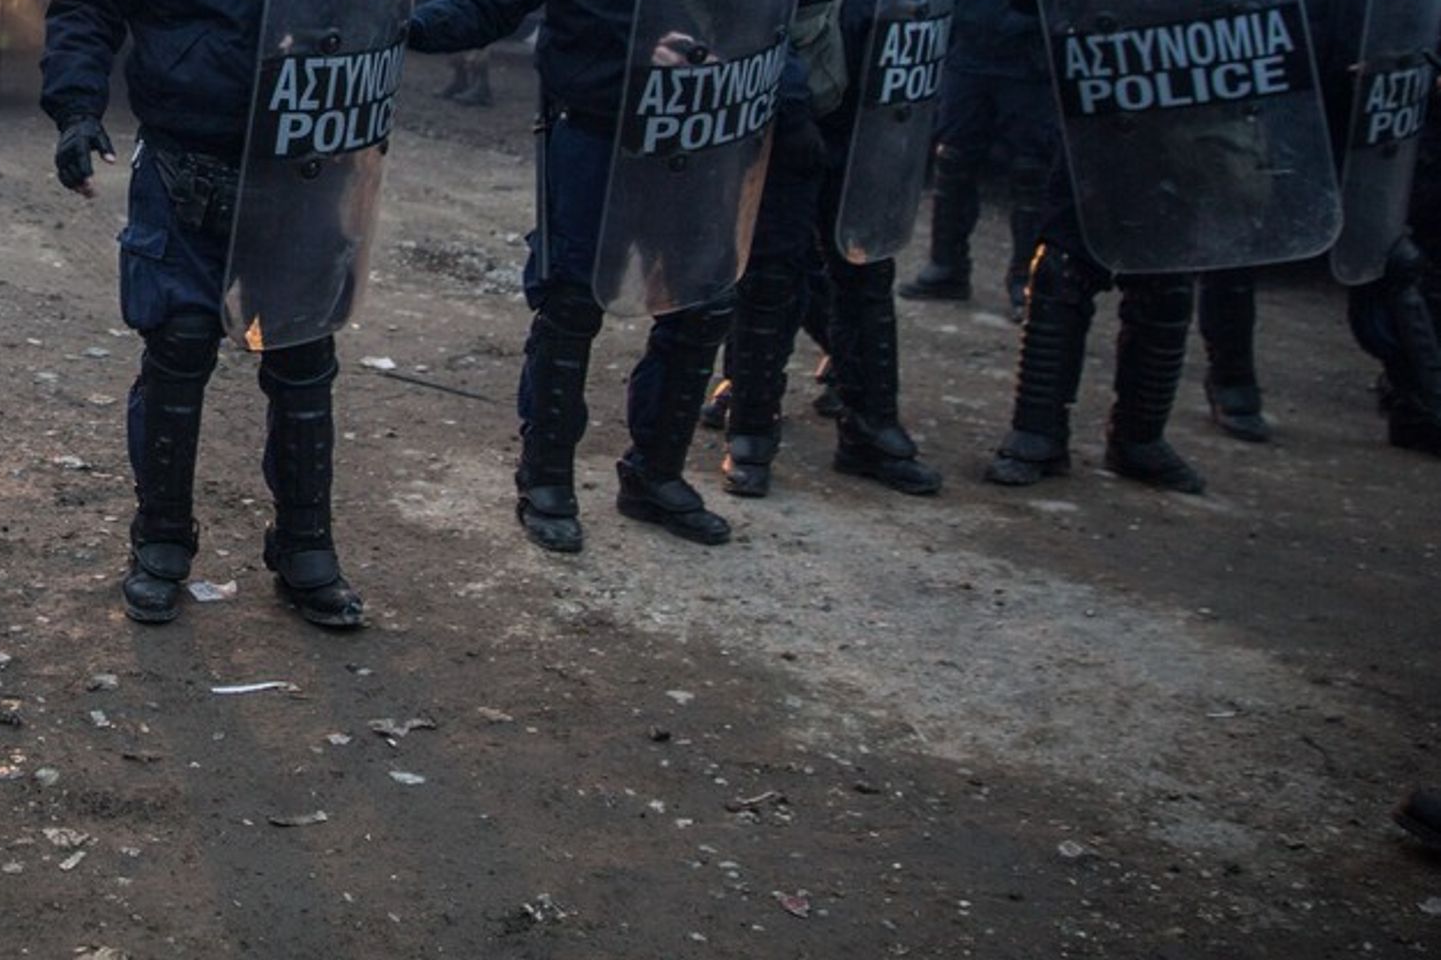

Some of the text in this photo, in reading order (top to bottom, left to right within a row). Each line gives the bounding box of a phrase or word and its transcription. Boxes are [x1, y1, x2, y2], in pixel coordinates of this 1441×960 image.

[1065, 8, 1294, 79] ΑΣΤΥΝΟΜΙΑ
[879, 59, 945, 104] POLI
[1078, 55, 1289, 114] POLICE
[275, 95, 396, 155] POLIC
